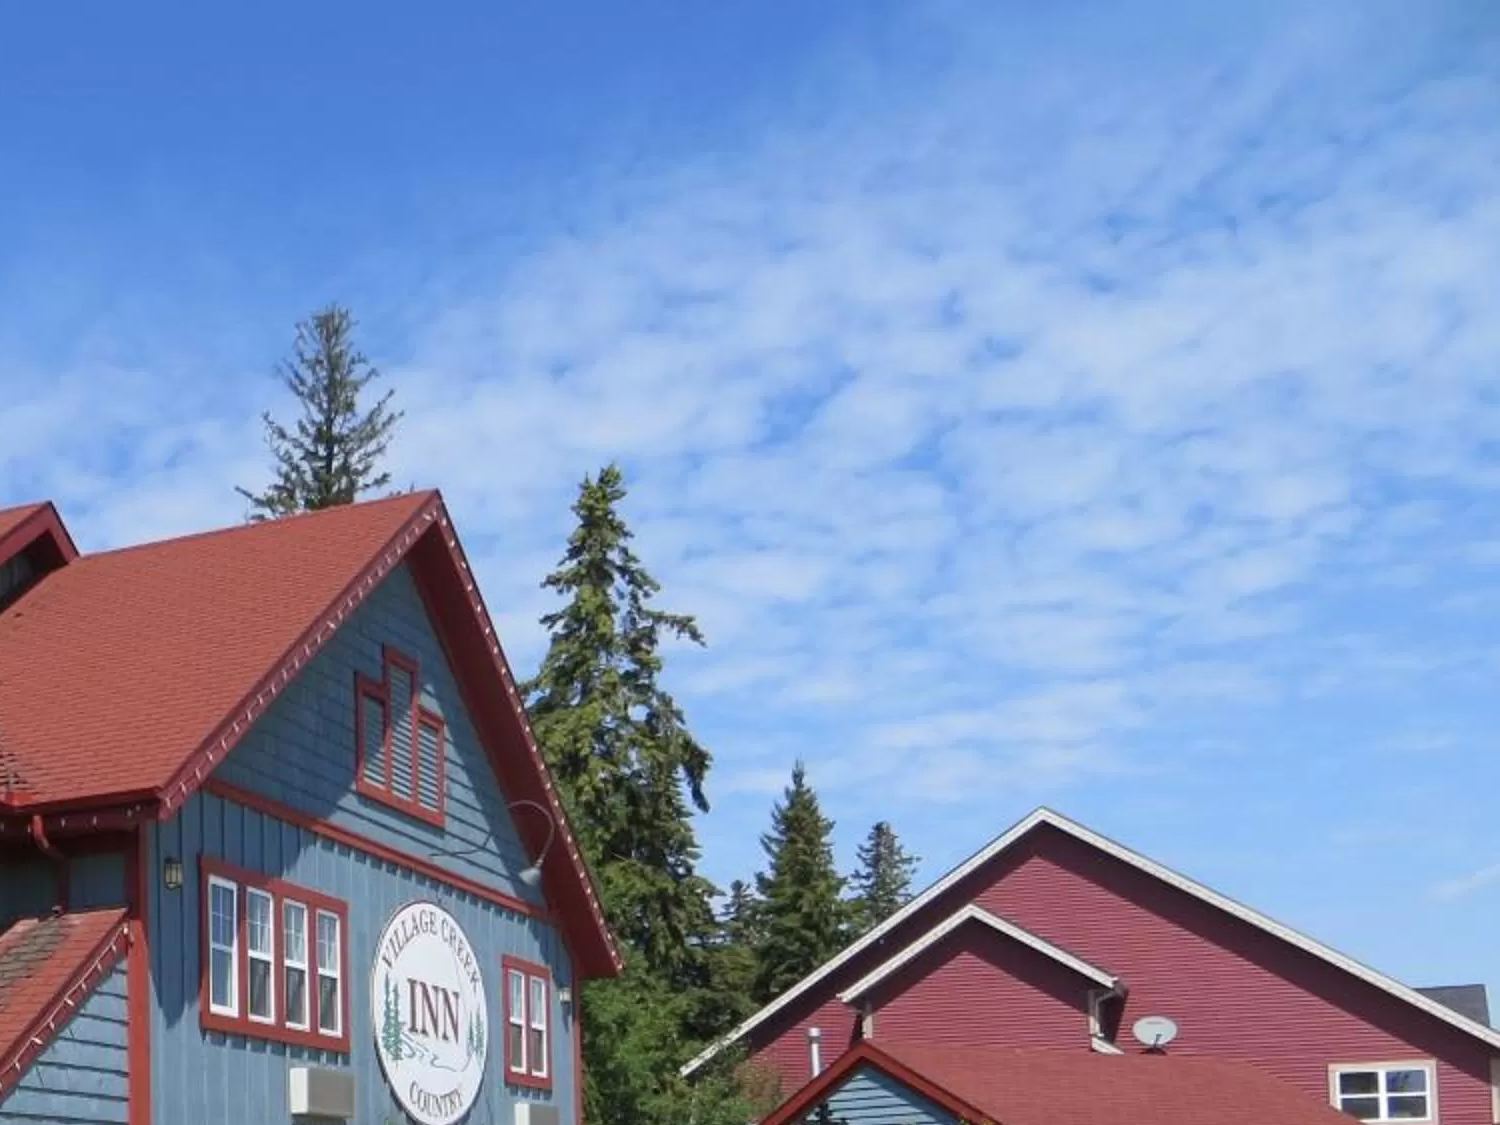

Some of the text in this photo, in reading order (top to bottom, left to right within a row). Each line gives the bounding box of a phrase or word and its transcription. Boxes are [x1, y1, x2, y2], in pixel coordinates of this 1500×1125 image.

[382, 908, 480, 997] VILLAGE CREEK
[407, 977, 460, 1046] INN
[409, 1080, 464, 1119] COUNTRY
